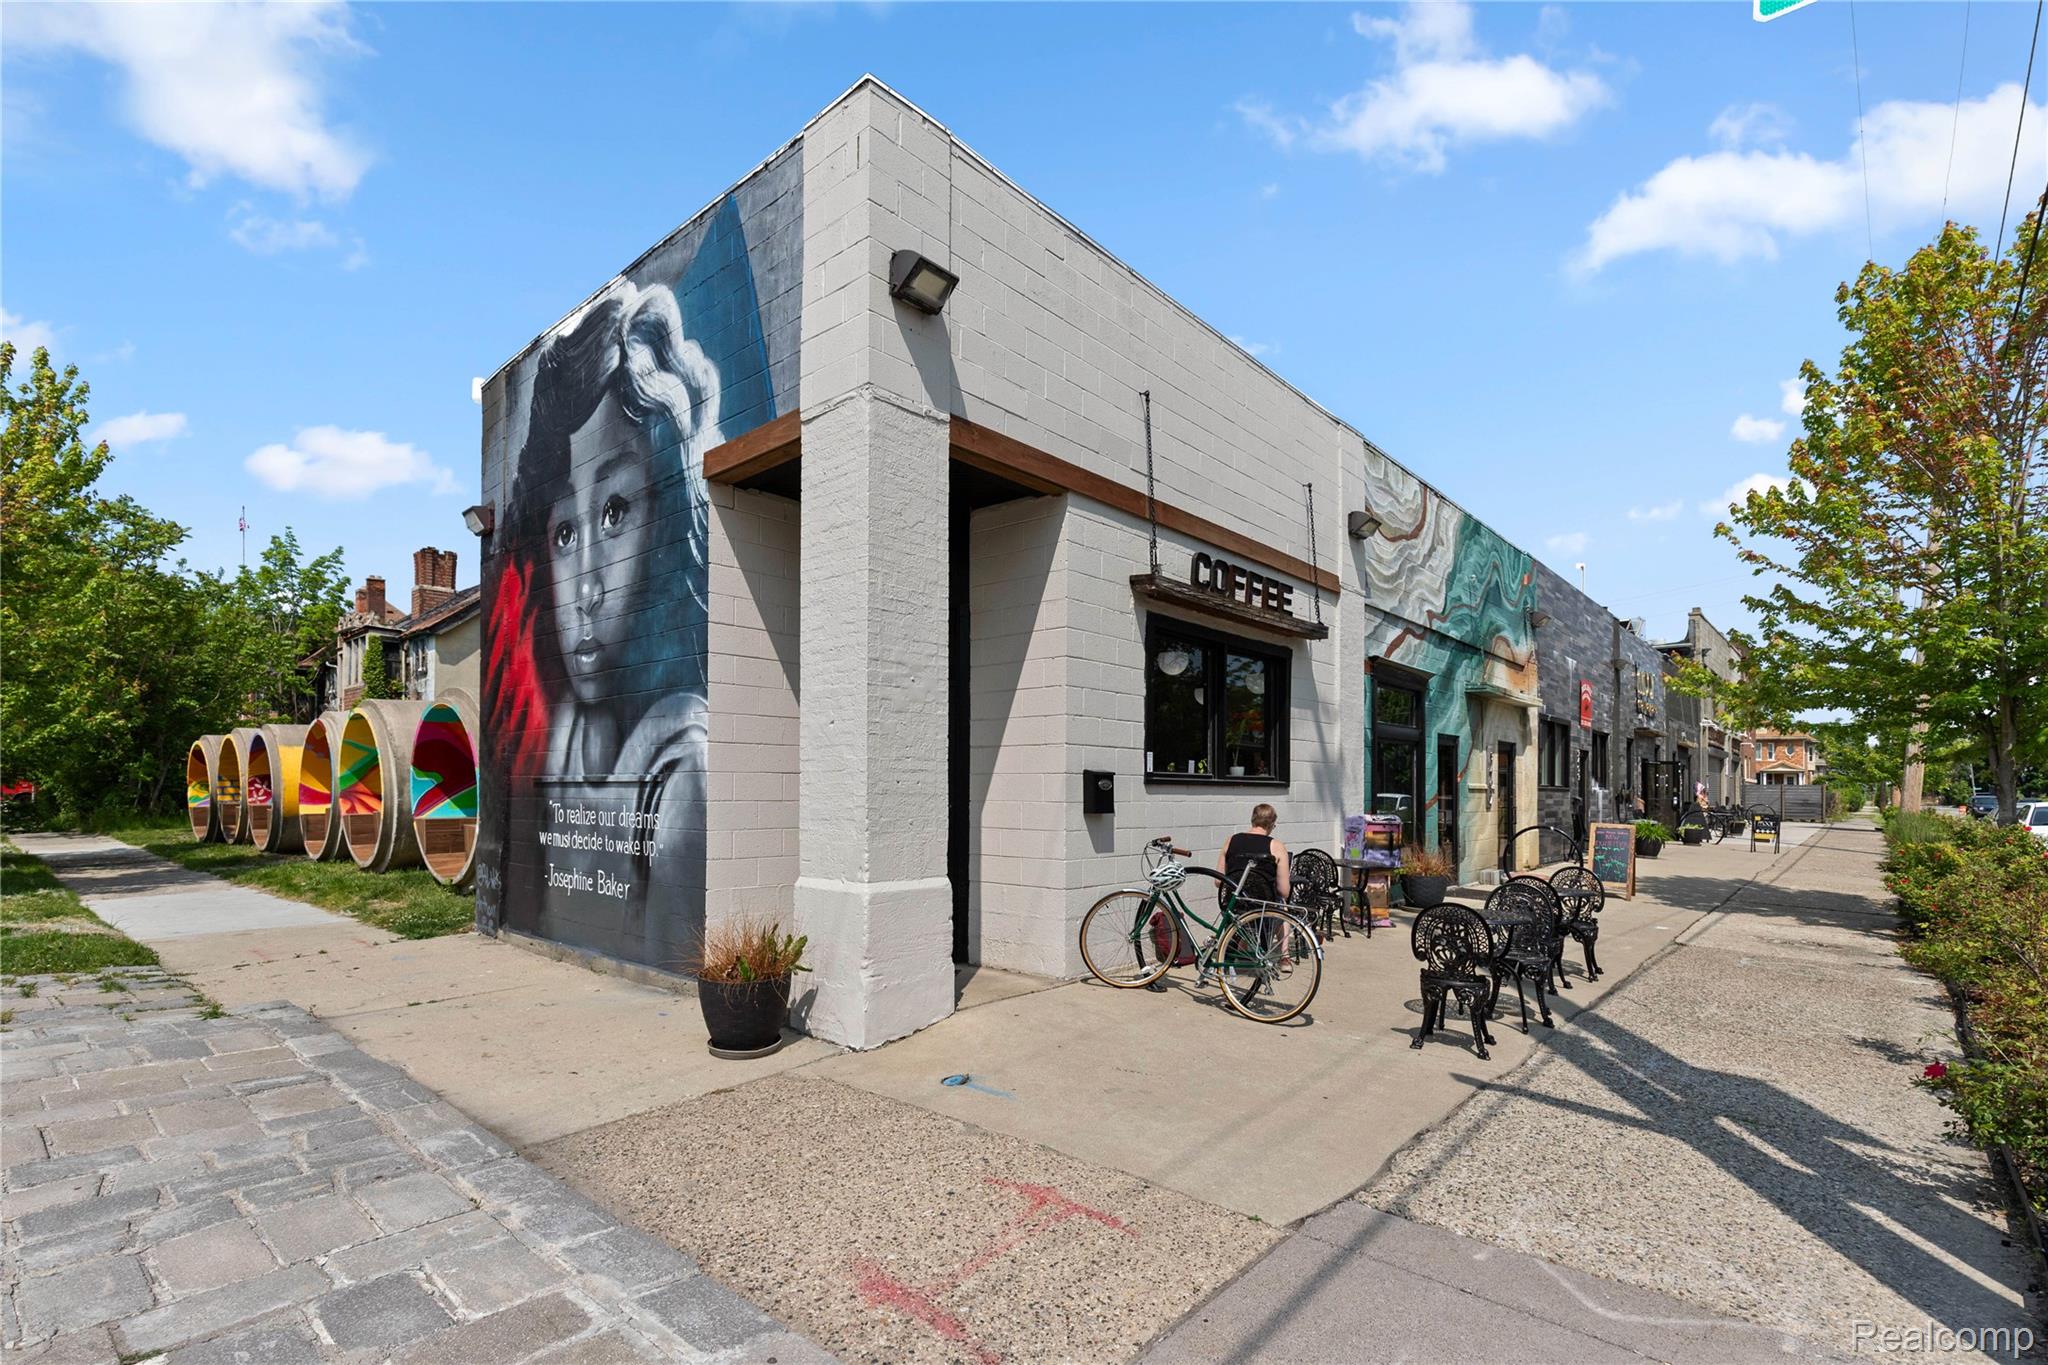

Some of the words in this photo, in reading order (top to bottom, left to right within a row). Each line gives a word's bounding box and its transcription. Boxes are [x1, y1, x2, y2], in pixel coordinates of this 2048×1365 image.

[1191, 552, 1293, 617] COFFEE
[566, 803, 596, 825] realize
[598, 810, 616, 827] our
[618, 804, 660, 830] dreams
[539, 831, 553, 846] we
[552, 830, 571, 848] must
[571, 830, 603, 850] decide
[605, 834, 614, 852] to
[615, 835, 641, 856] wake
[544, 863, 593, 896] -Josephine
[597, 869, 631, 900] Baker
